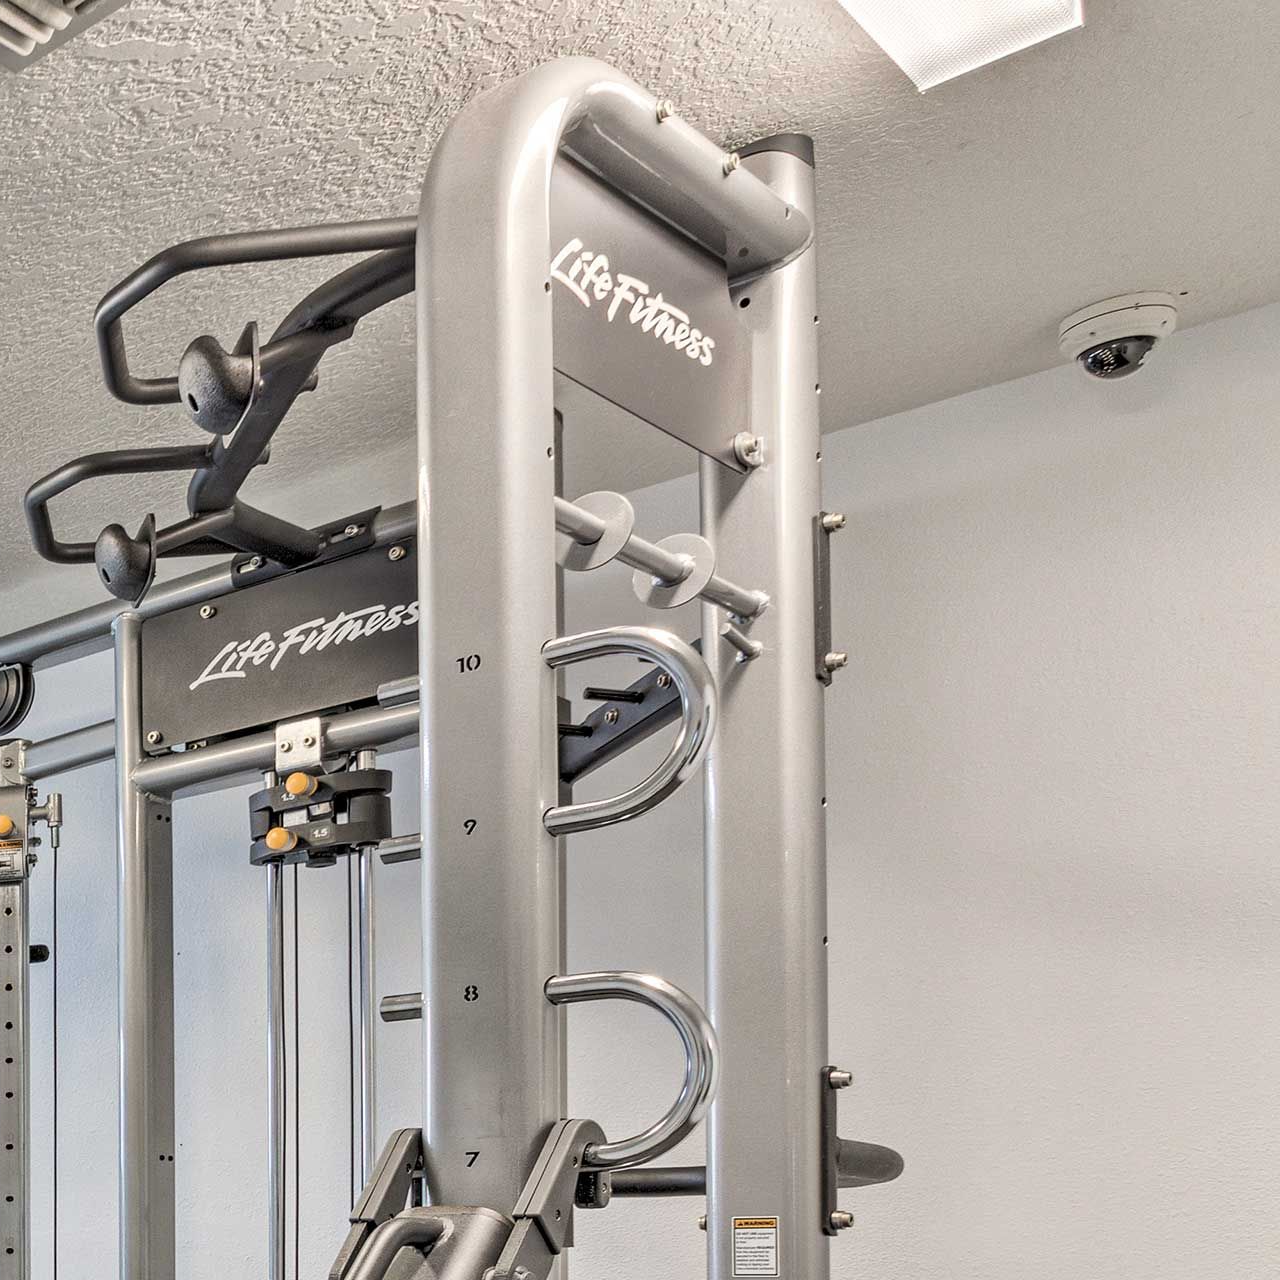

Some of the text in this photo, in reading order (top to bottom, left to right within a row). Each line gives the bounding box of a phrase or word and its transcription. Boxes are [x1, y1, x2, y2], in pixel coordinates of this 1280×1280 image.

[456, 654, 482, 674] 10
[313, 828, 328, 838] 1.5
[463, 819, 477, 836] 9
[464, 985, 479, 1001] 8
[465, 1151, 481, 1168] 7
